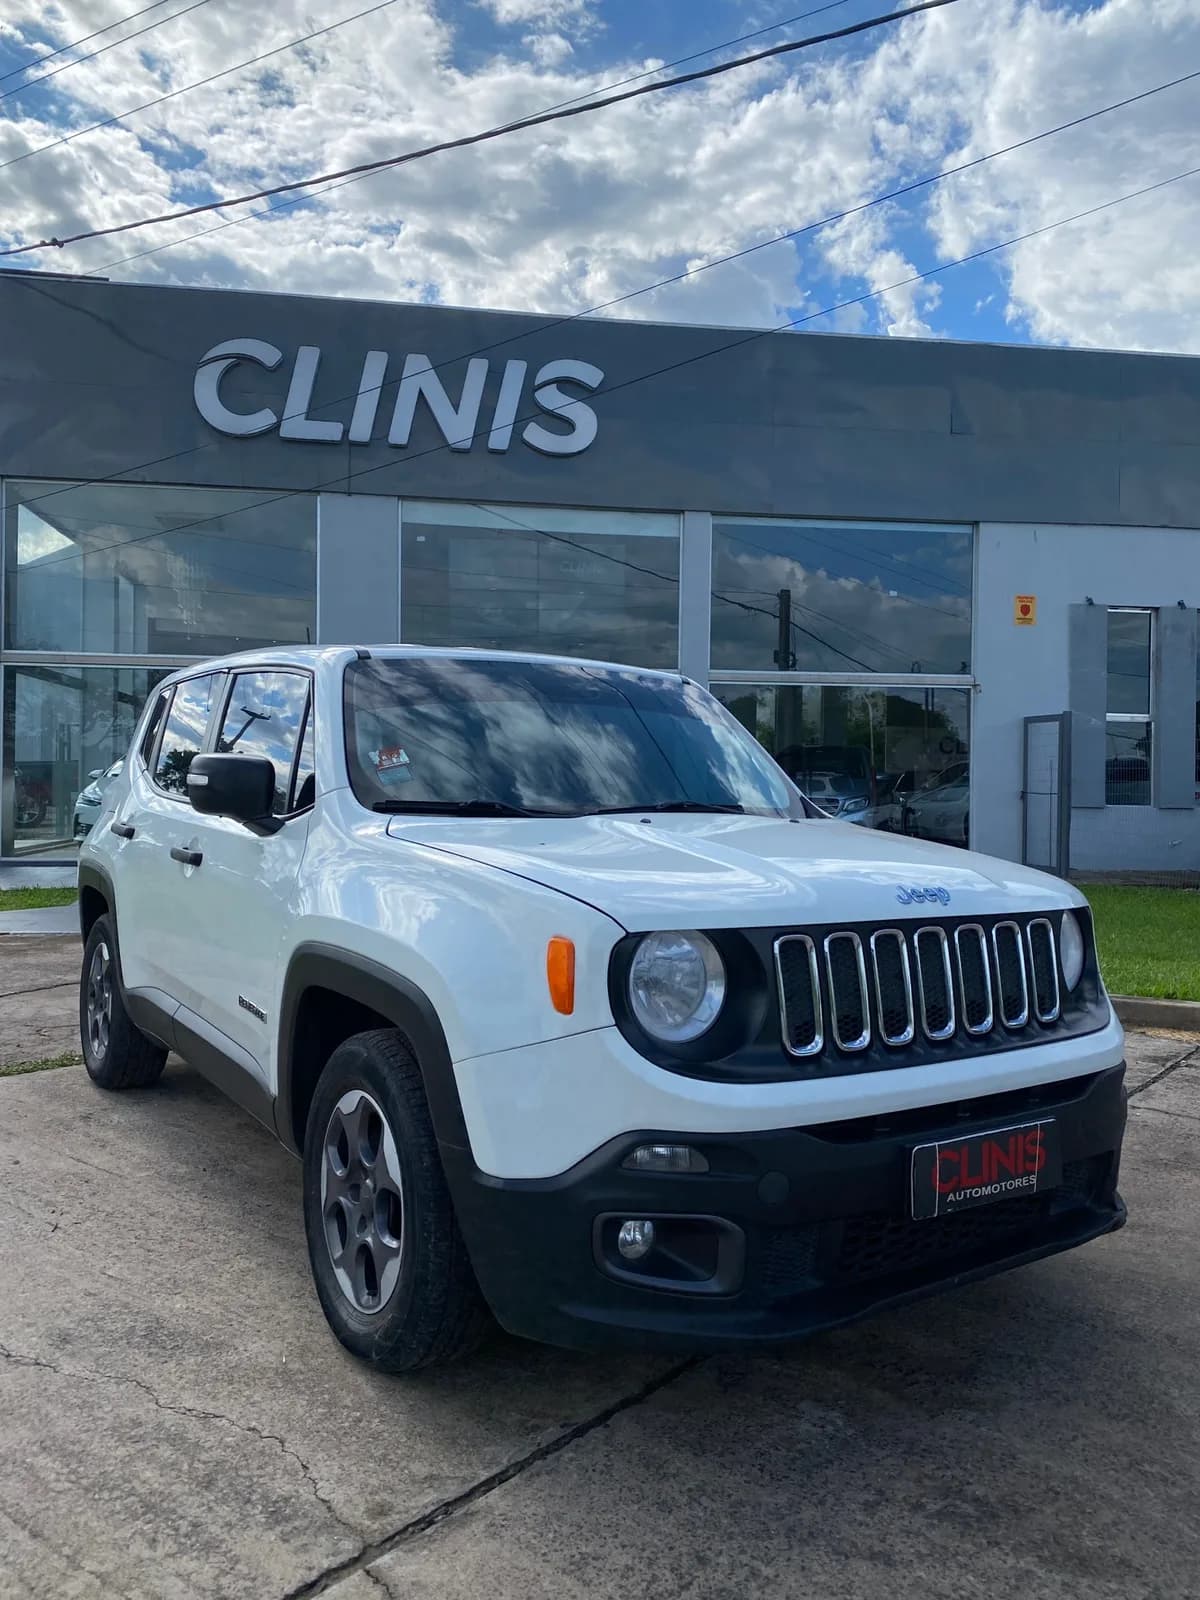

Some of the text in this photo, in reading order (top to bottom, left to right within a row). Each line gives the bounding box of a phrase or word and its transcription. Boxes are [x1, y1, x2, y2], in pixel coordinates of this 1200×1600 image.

[193, 337, 605, 457] CLINIS
[896, 885, 951, 907] Jeep
[931, 1130, 1047, 1193] CLINIS
[947, 1174, 1037, 1203] AUTOMOTORES
